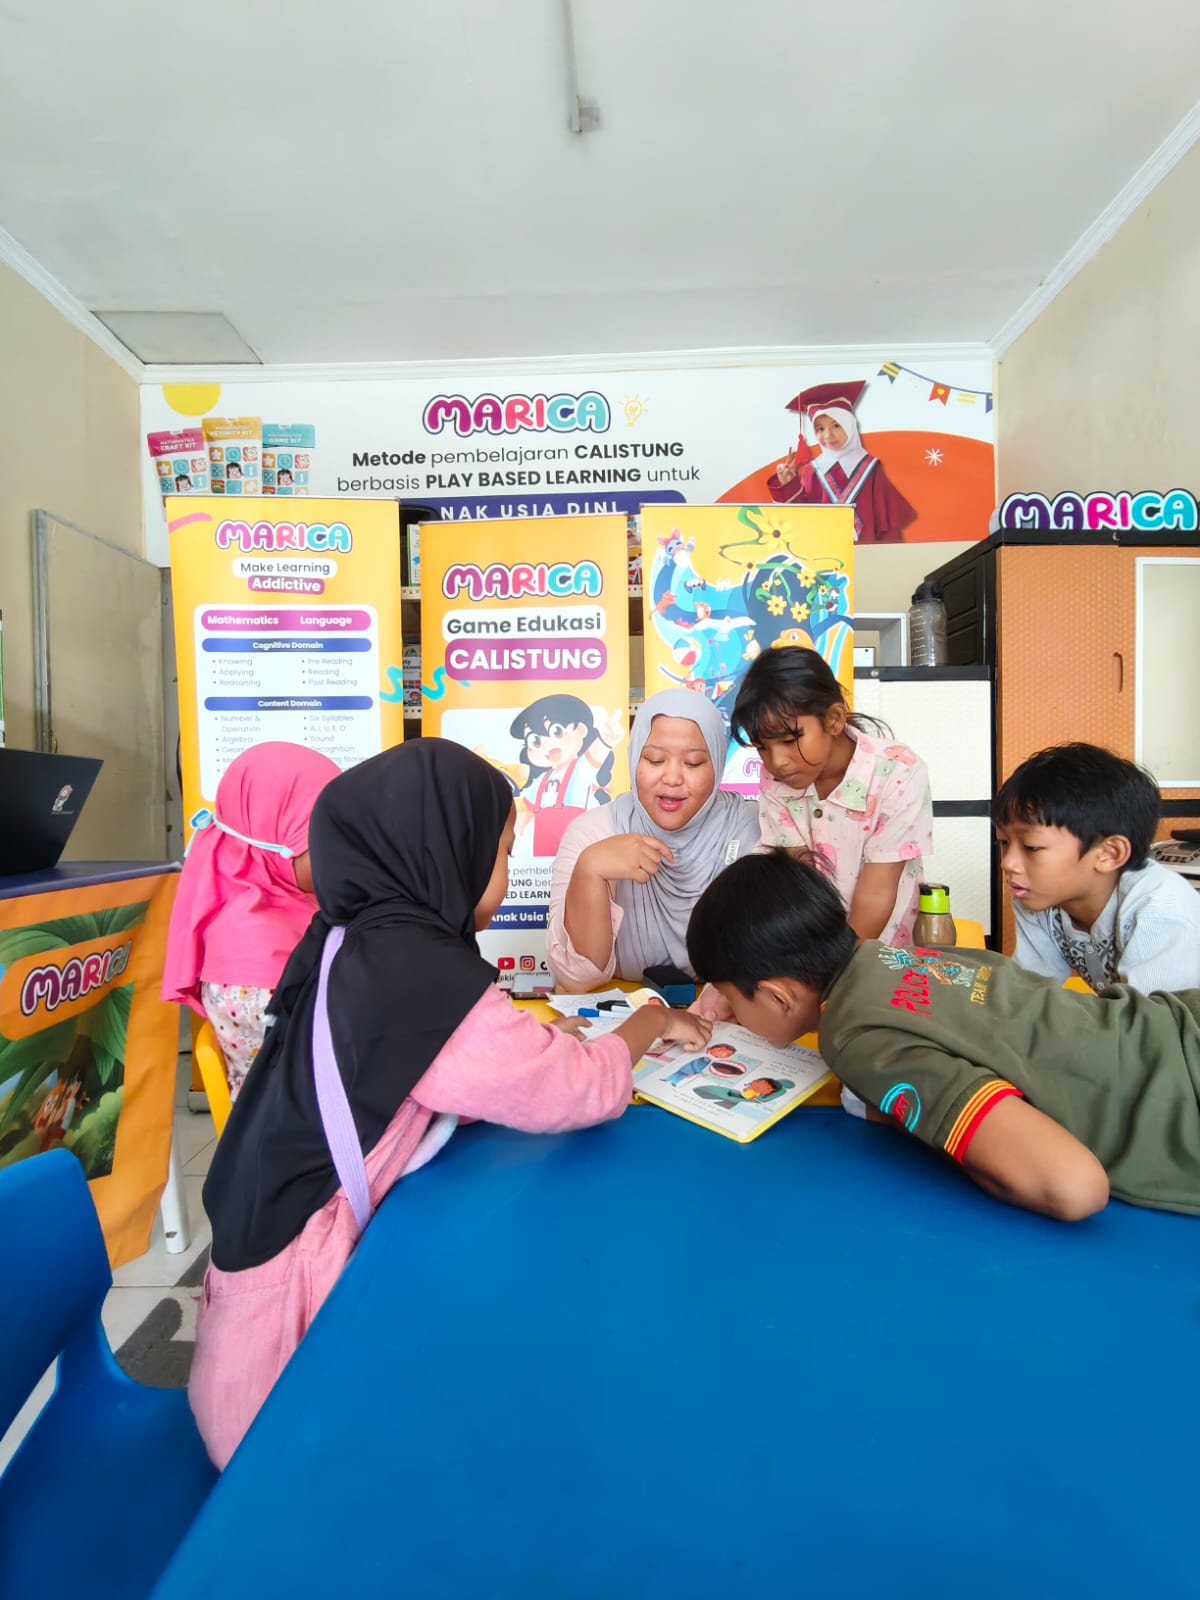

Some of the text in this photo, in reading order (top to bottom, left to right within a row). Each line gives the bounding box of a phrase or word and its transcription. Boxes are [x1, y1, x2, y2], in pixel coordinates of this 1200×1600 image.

[424, 392, 610, 437] MARICA
[352, 442, 684, 468] Metode pembelajaran CALISTUNG
[337, 466, 700, 491] berbasis PLAY BASED LEARNING untuk
[440, 501, 618, 520] NAK USIA DINI
[1001, 489, 1197, 530] MARICA
[216, 520, 352, 552] MARICA
[240, 562, 330, 575] Make Learning
[251, 577, 321, 592] Addictive
[442, 560, 603, 601] MARICA
[207, 615, 353, 627] Mathematics Language
[447, 612, 601, 634] Game Edukasi
[252, 642, 324, 651] Cognitive Domain
[218, 658, 253, 667] Knowing
[321, 658, 353, 666] Reading
[450, 648, 602, 670] CALISTUNG
[219, 669, 254, 677] Applying
[308, 669, 340, 677] Reading
[219, 679, 261, 687] Reasoning
[326, 679, 358, 687] Reading
[512, 866, 552, 877] pembel
[509, 878, 532, 887] UNG
[519, 911, 544, 922] Usia
